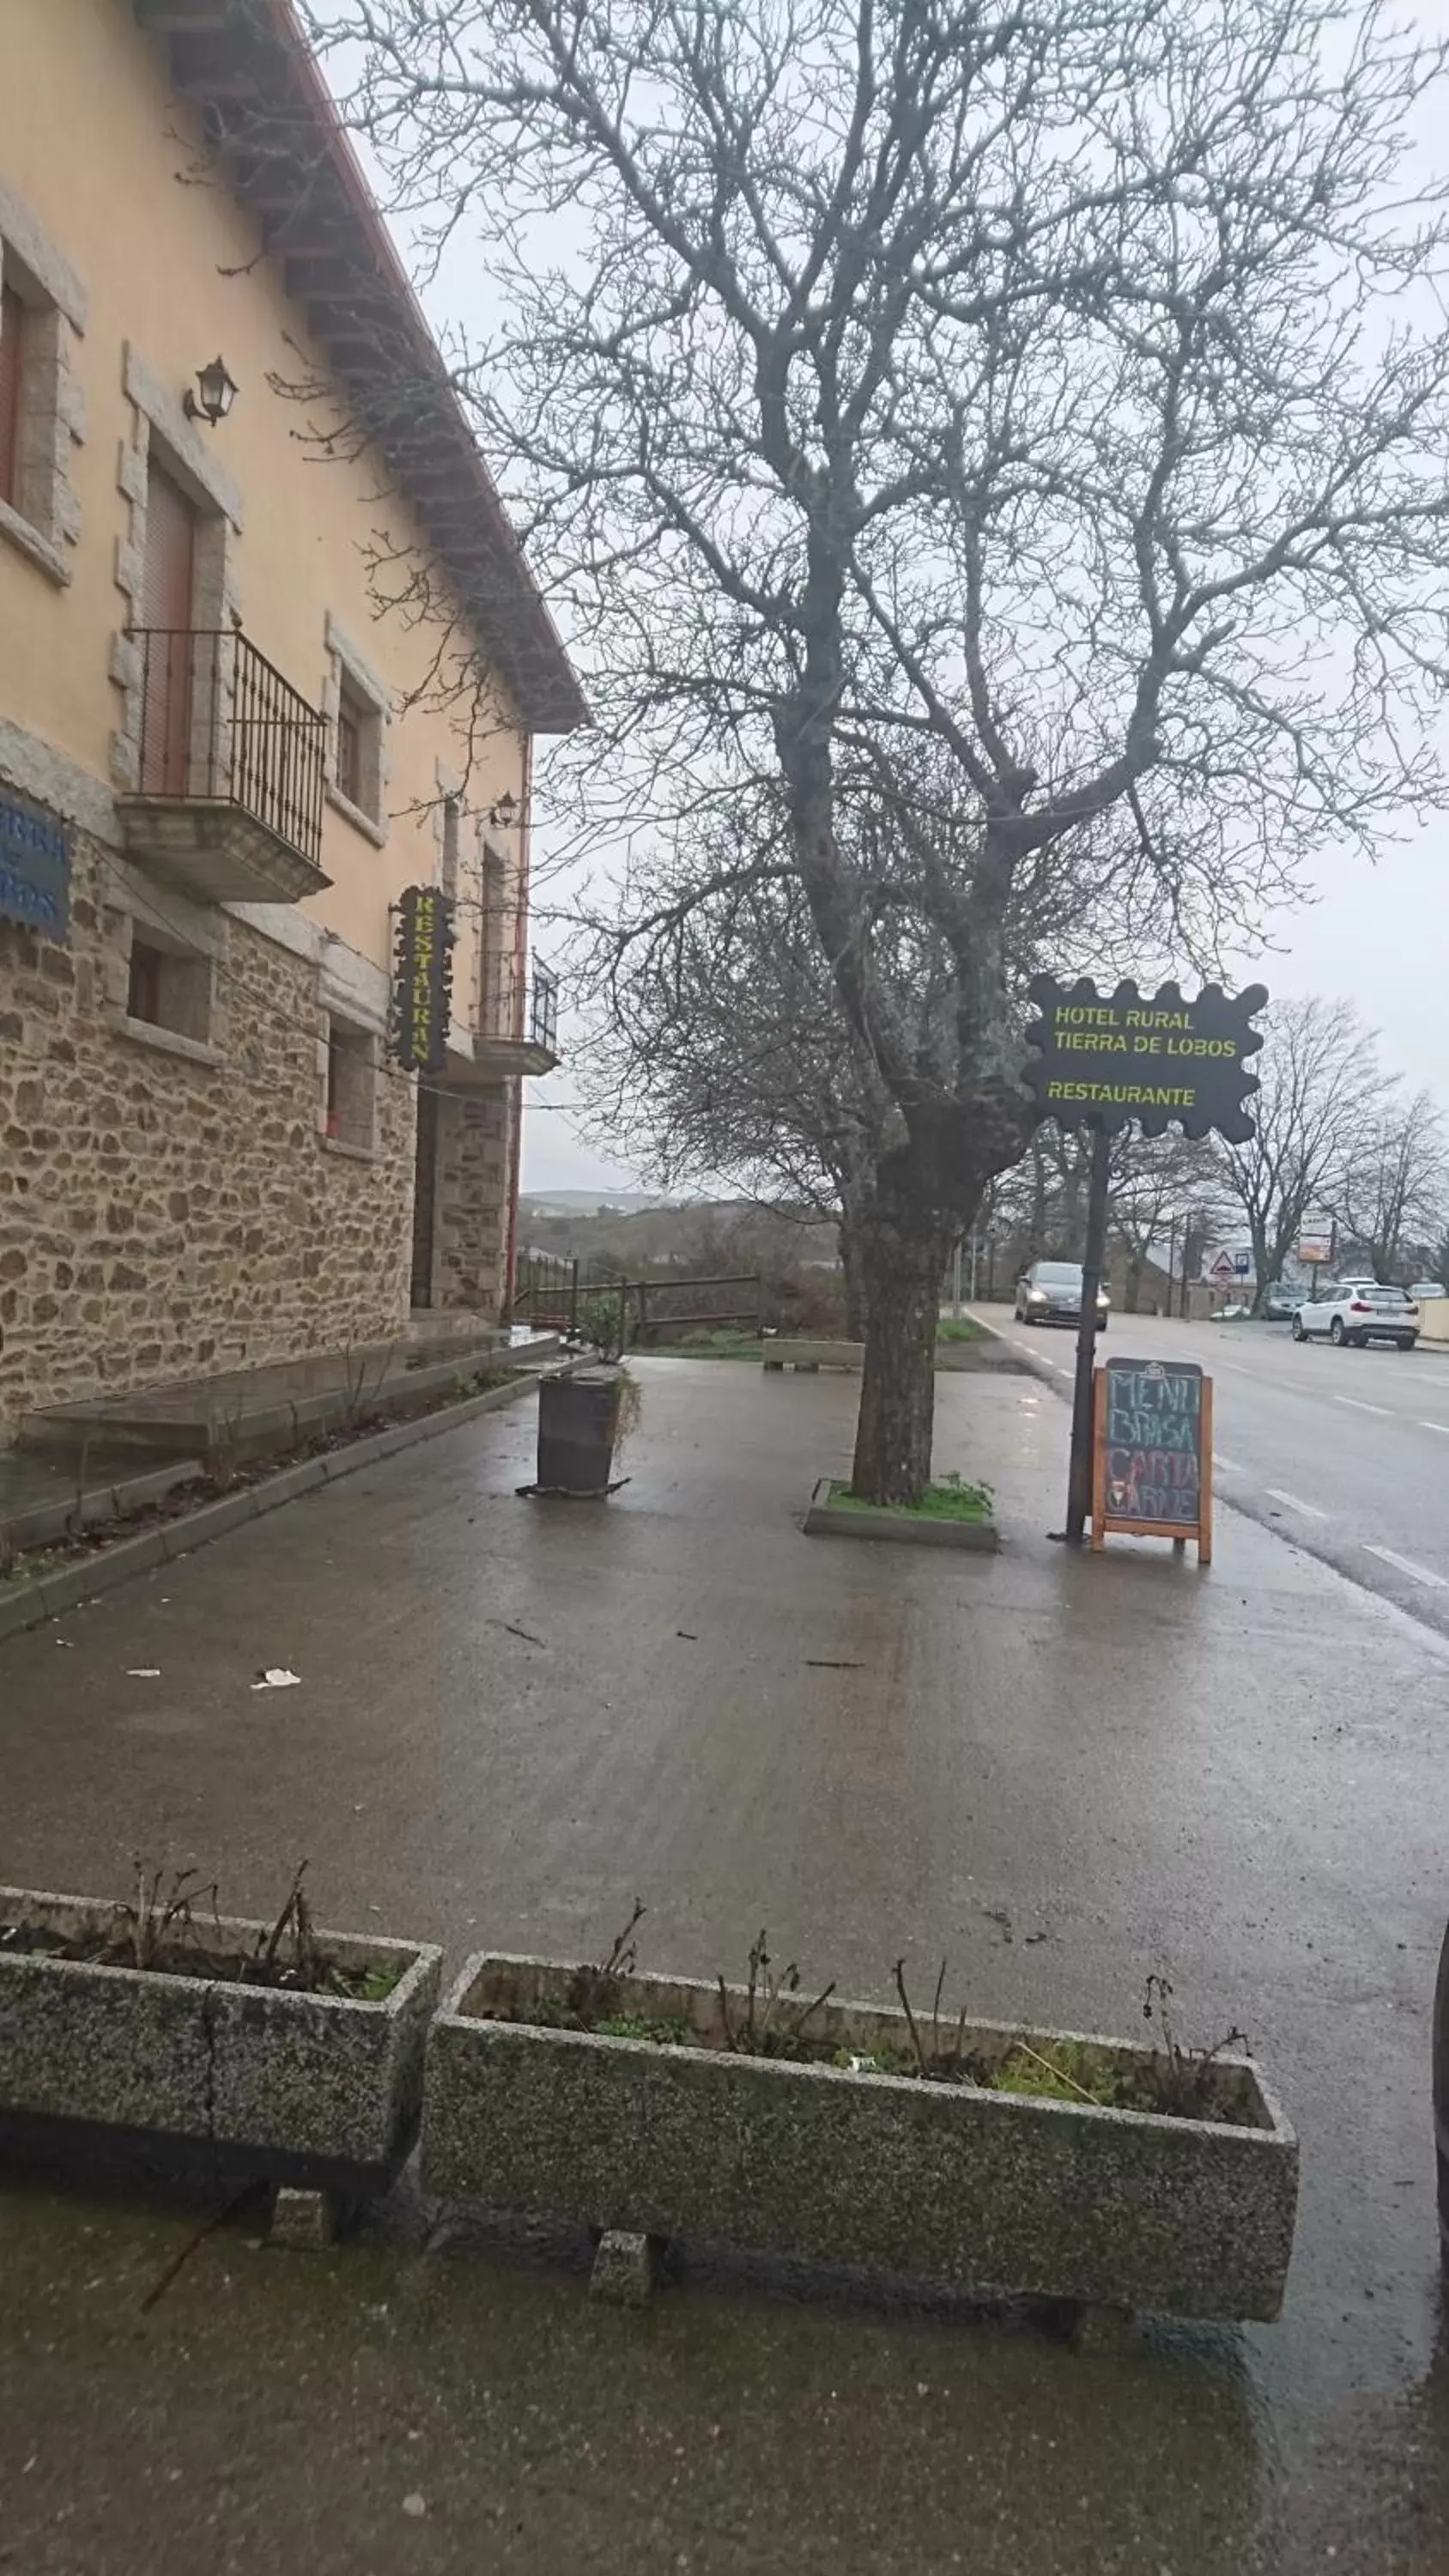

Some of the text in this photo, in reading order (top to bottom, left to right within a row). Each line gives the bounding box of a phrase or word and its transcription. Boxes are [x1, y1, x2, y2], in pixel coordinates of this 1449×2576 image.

[1055, 1006, 1195, 1030] HOTEL RURAL
[1055, 1031, 1237, 1057] TIERRA DE LOBOS
[1048, 1081, 1196, 1106] RESTAURANTE
